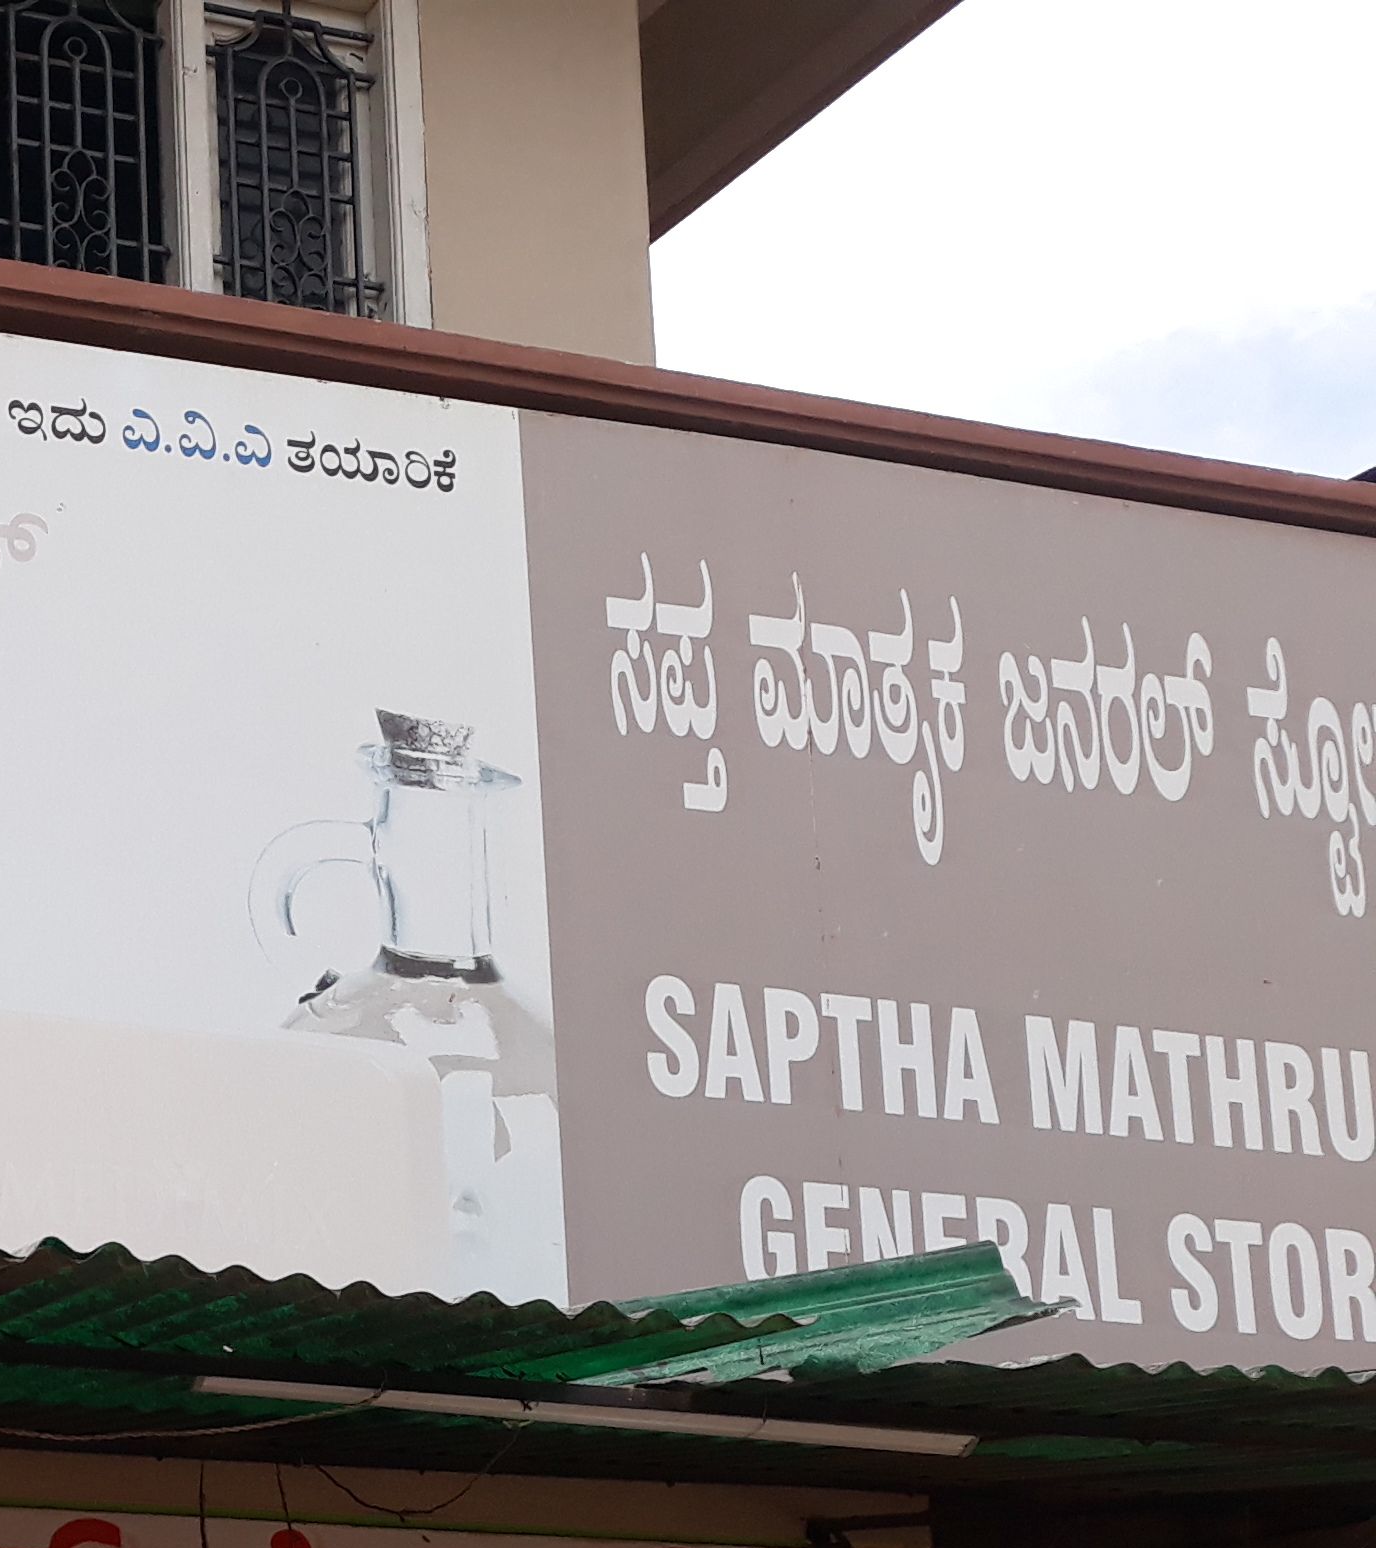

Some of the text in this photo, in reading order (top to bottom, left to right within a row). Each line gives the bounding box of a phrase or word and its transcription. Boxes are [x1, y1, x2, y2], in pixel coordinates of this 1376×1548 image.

[7, 397, 107, 445] ಇದು
[286, 430, 458, 492] ತಯಾರಿಕೆ
[605, 551, 729, 812] ಸಪ್ತ
[748, 571, 966, 865] ಮಾತೃಕ
[998, 615, 1214, 802] ಜನರಲ್
[646, 974, 1000, 1126] SAPTHA
